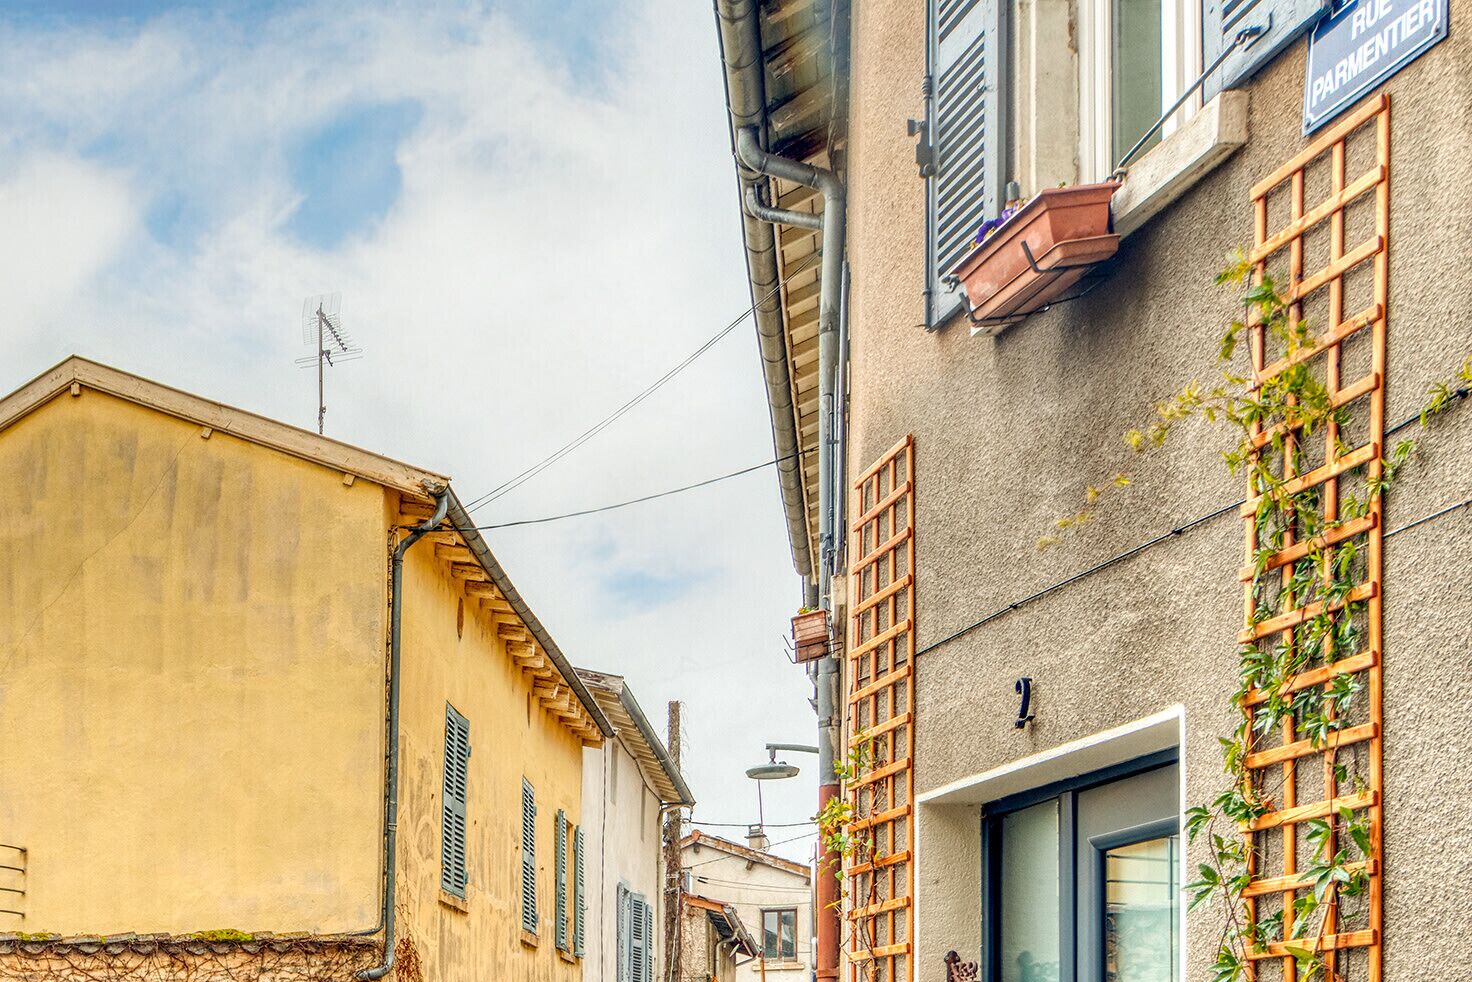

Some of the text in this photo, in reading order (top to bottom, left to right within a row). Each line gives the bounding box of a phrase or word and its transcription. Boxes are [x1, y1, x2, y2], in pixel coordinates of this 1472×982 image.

[1351, 0, 1393, 40] RUE
[1311, 0, 1434, 108] PARMENTIER
[1014, 677, 1035, 729] 2
